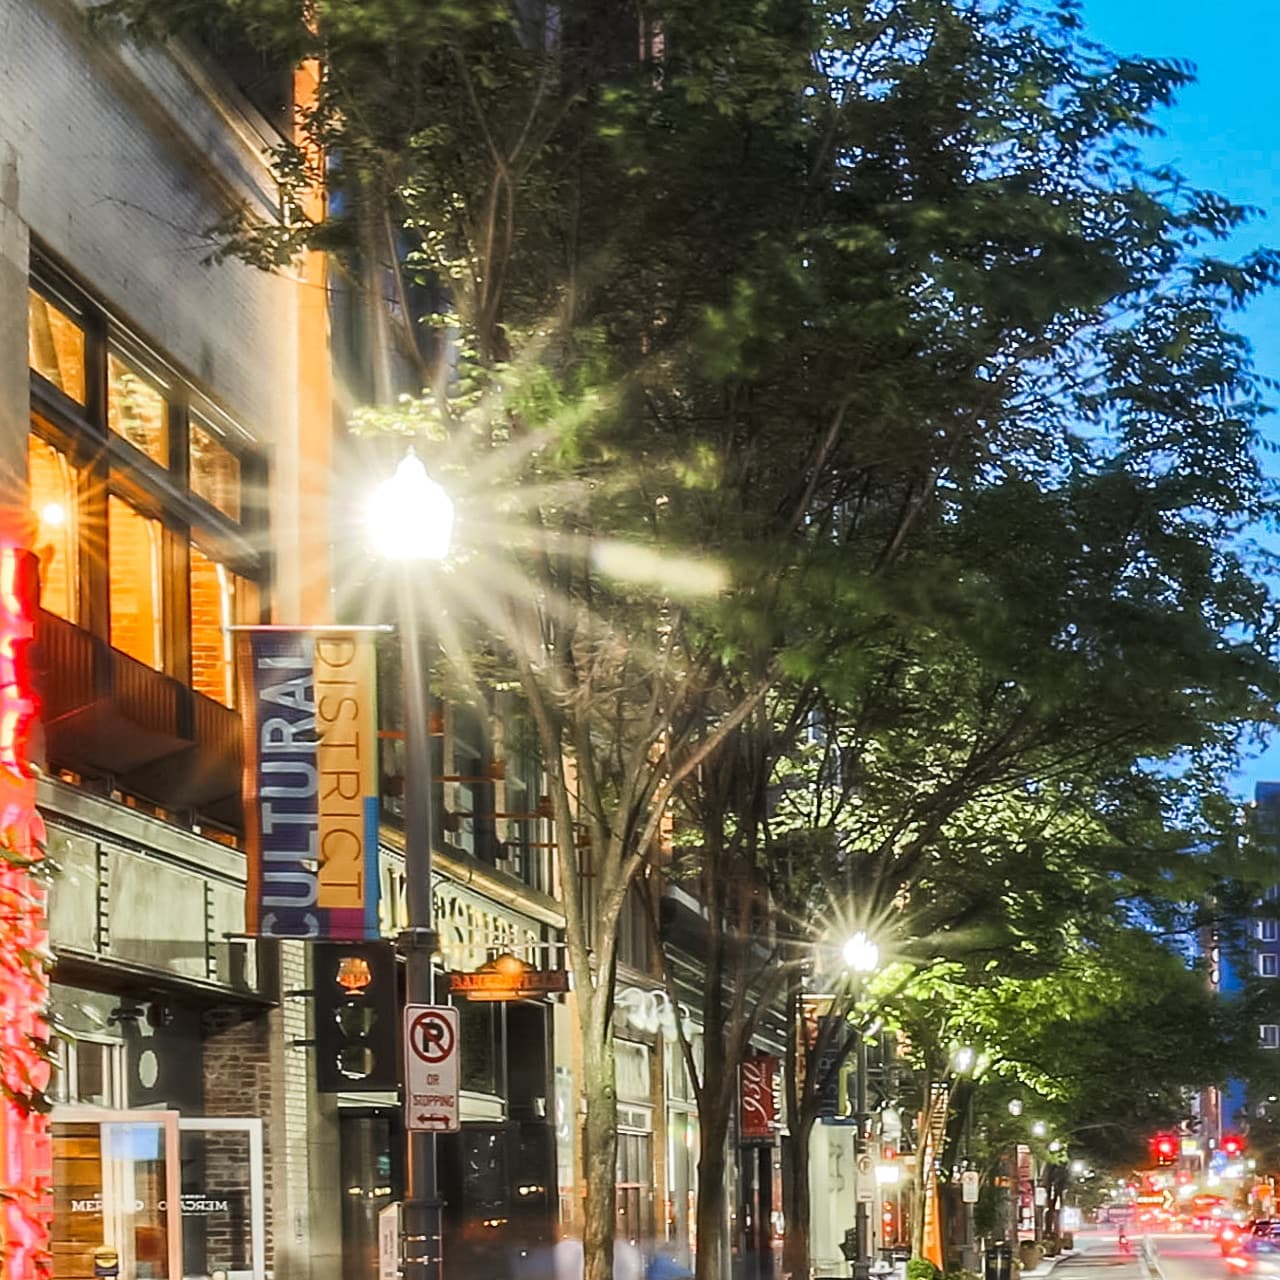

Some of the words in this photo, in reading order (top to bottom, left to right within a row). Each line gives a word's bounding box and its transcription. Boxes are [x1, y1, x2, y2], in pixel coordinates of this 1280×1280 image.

[257, 632, 320, 939] CULTURAL
[315, 636, 363, 900] DISTRICT
[413, 1094, 455, 1107] STOPPING
[743, 1062, 769, 1124] 930
